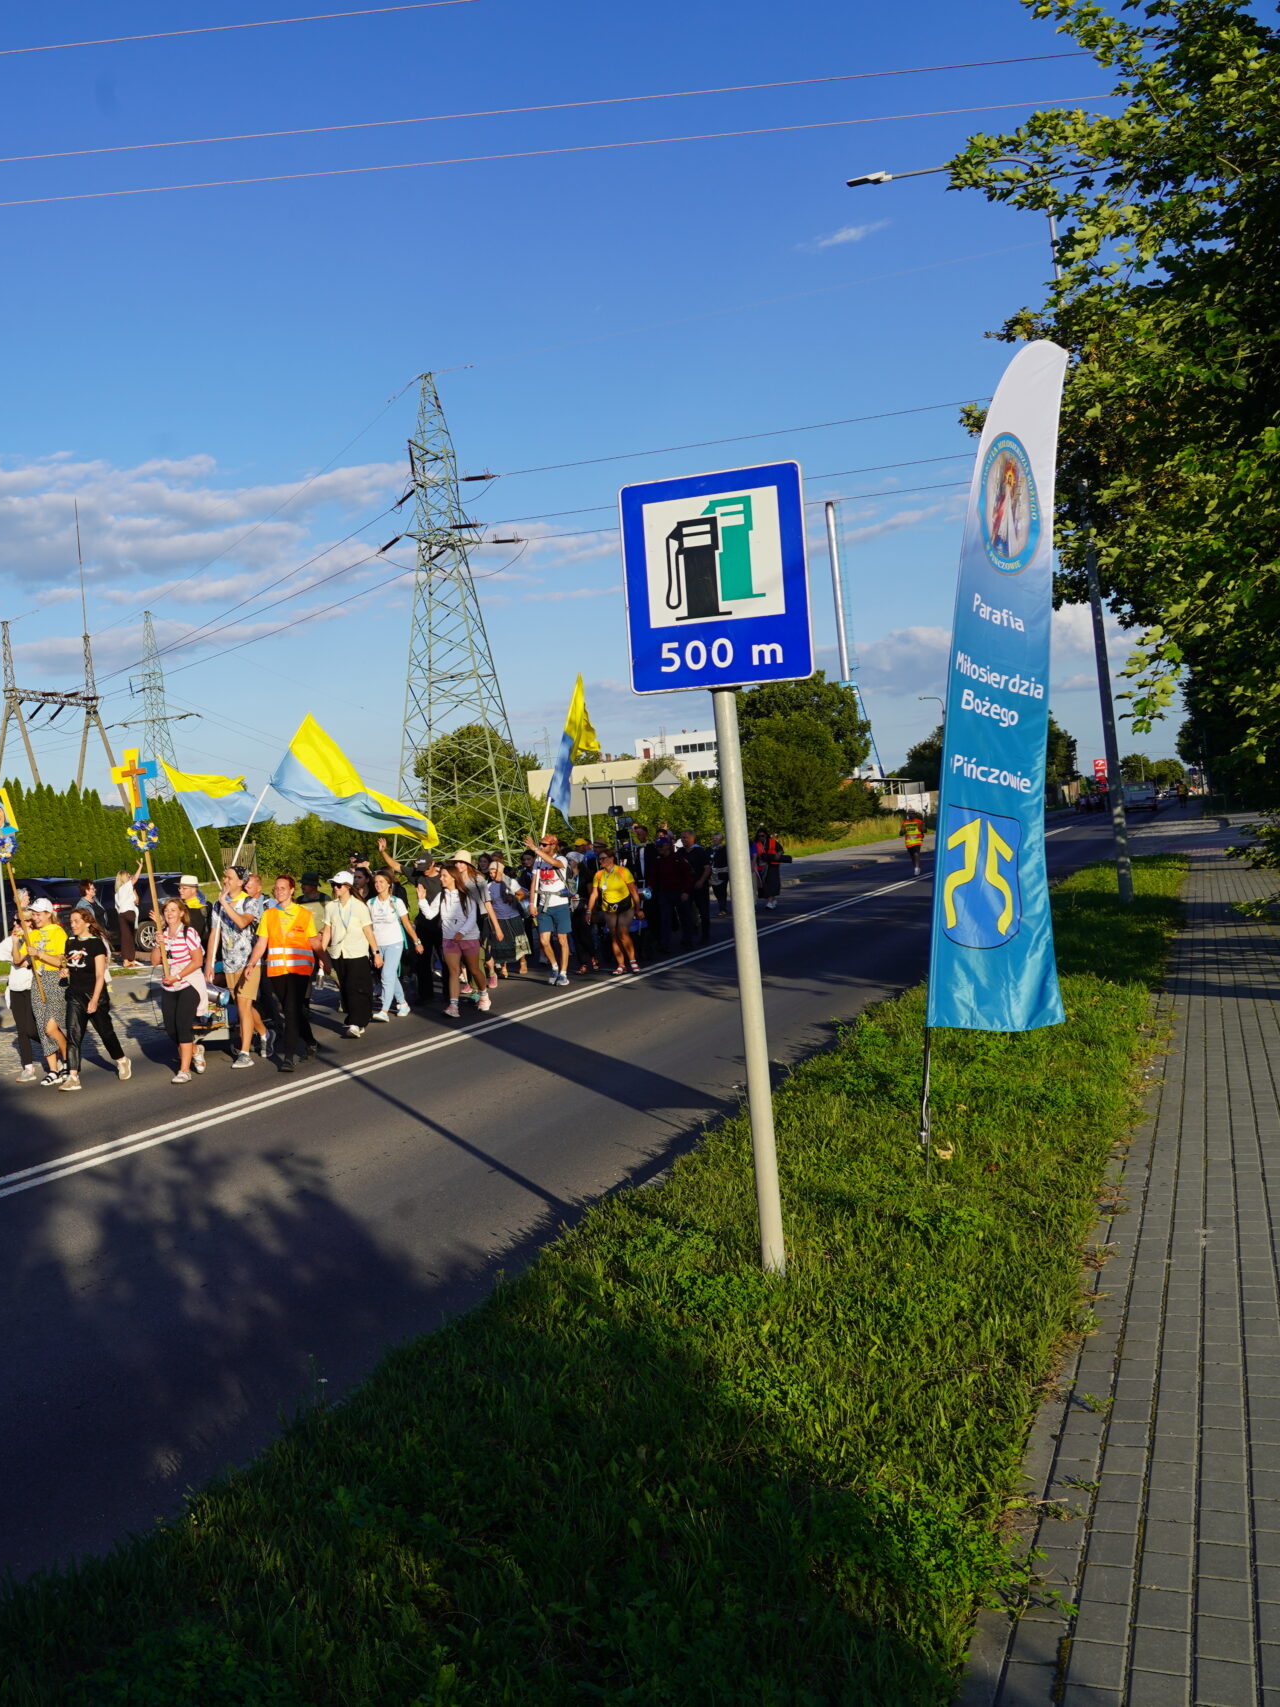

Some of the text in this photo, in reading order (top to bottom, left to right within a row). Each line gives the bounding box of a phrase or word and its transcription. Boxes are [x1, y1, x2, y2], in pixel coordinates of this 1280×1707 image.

[973, 592, 1025, 632] Parafia
[660, 638, 784, 673] 500 m
[955, 650, 1044, 699] Miłosierdzia
[961, 688, 1019, 727] Bożego
[953, 753, 1032, 793] Pińczowie
